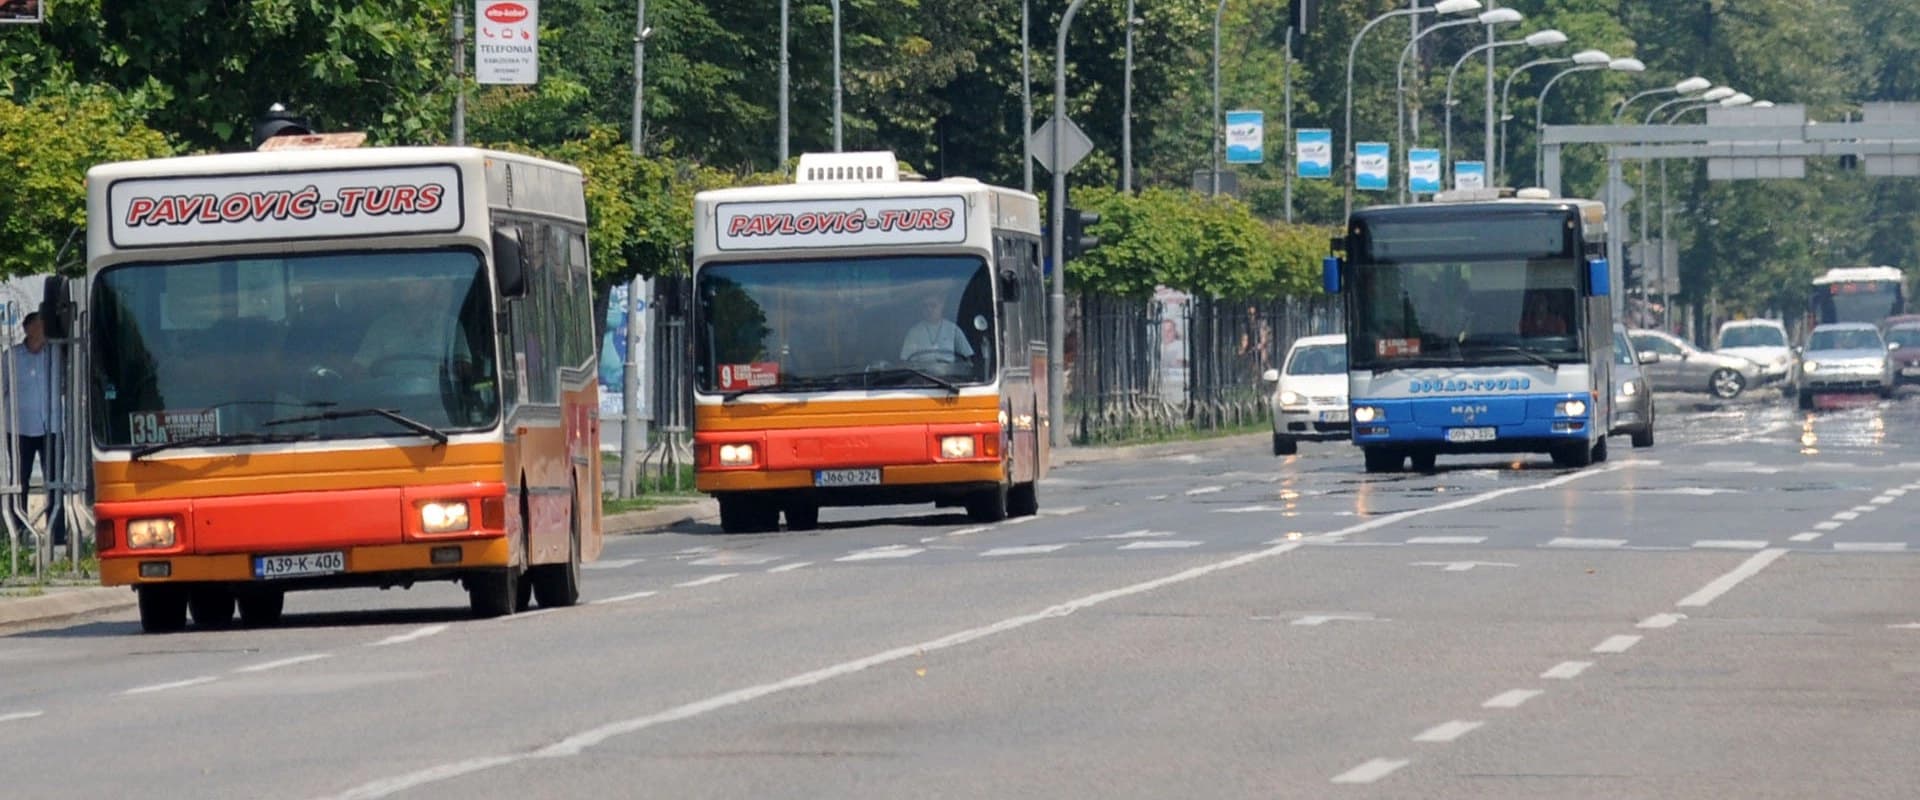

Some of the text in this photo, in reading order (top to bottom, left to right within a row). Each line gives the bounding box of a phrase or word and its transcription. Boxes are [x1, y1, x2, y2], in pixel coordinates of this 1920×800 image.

[480, 45, 533, 53] TELEFONIJA
[721, 365, 732, 389] 9
[1450, 404, 1489, 414] MAN
